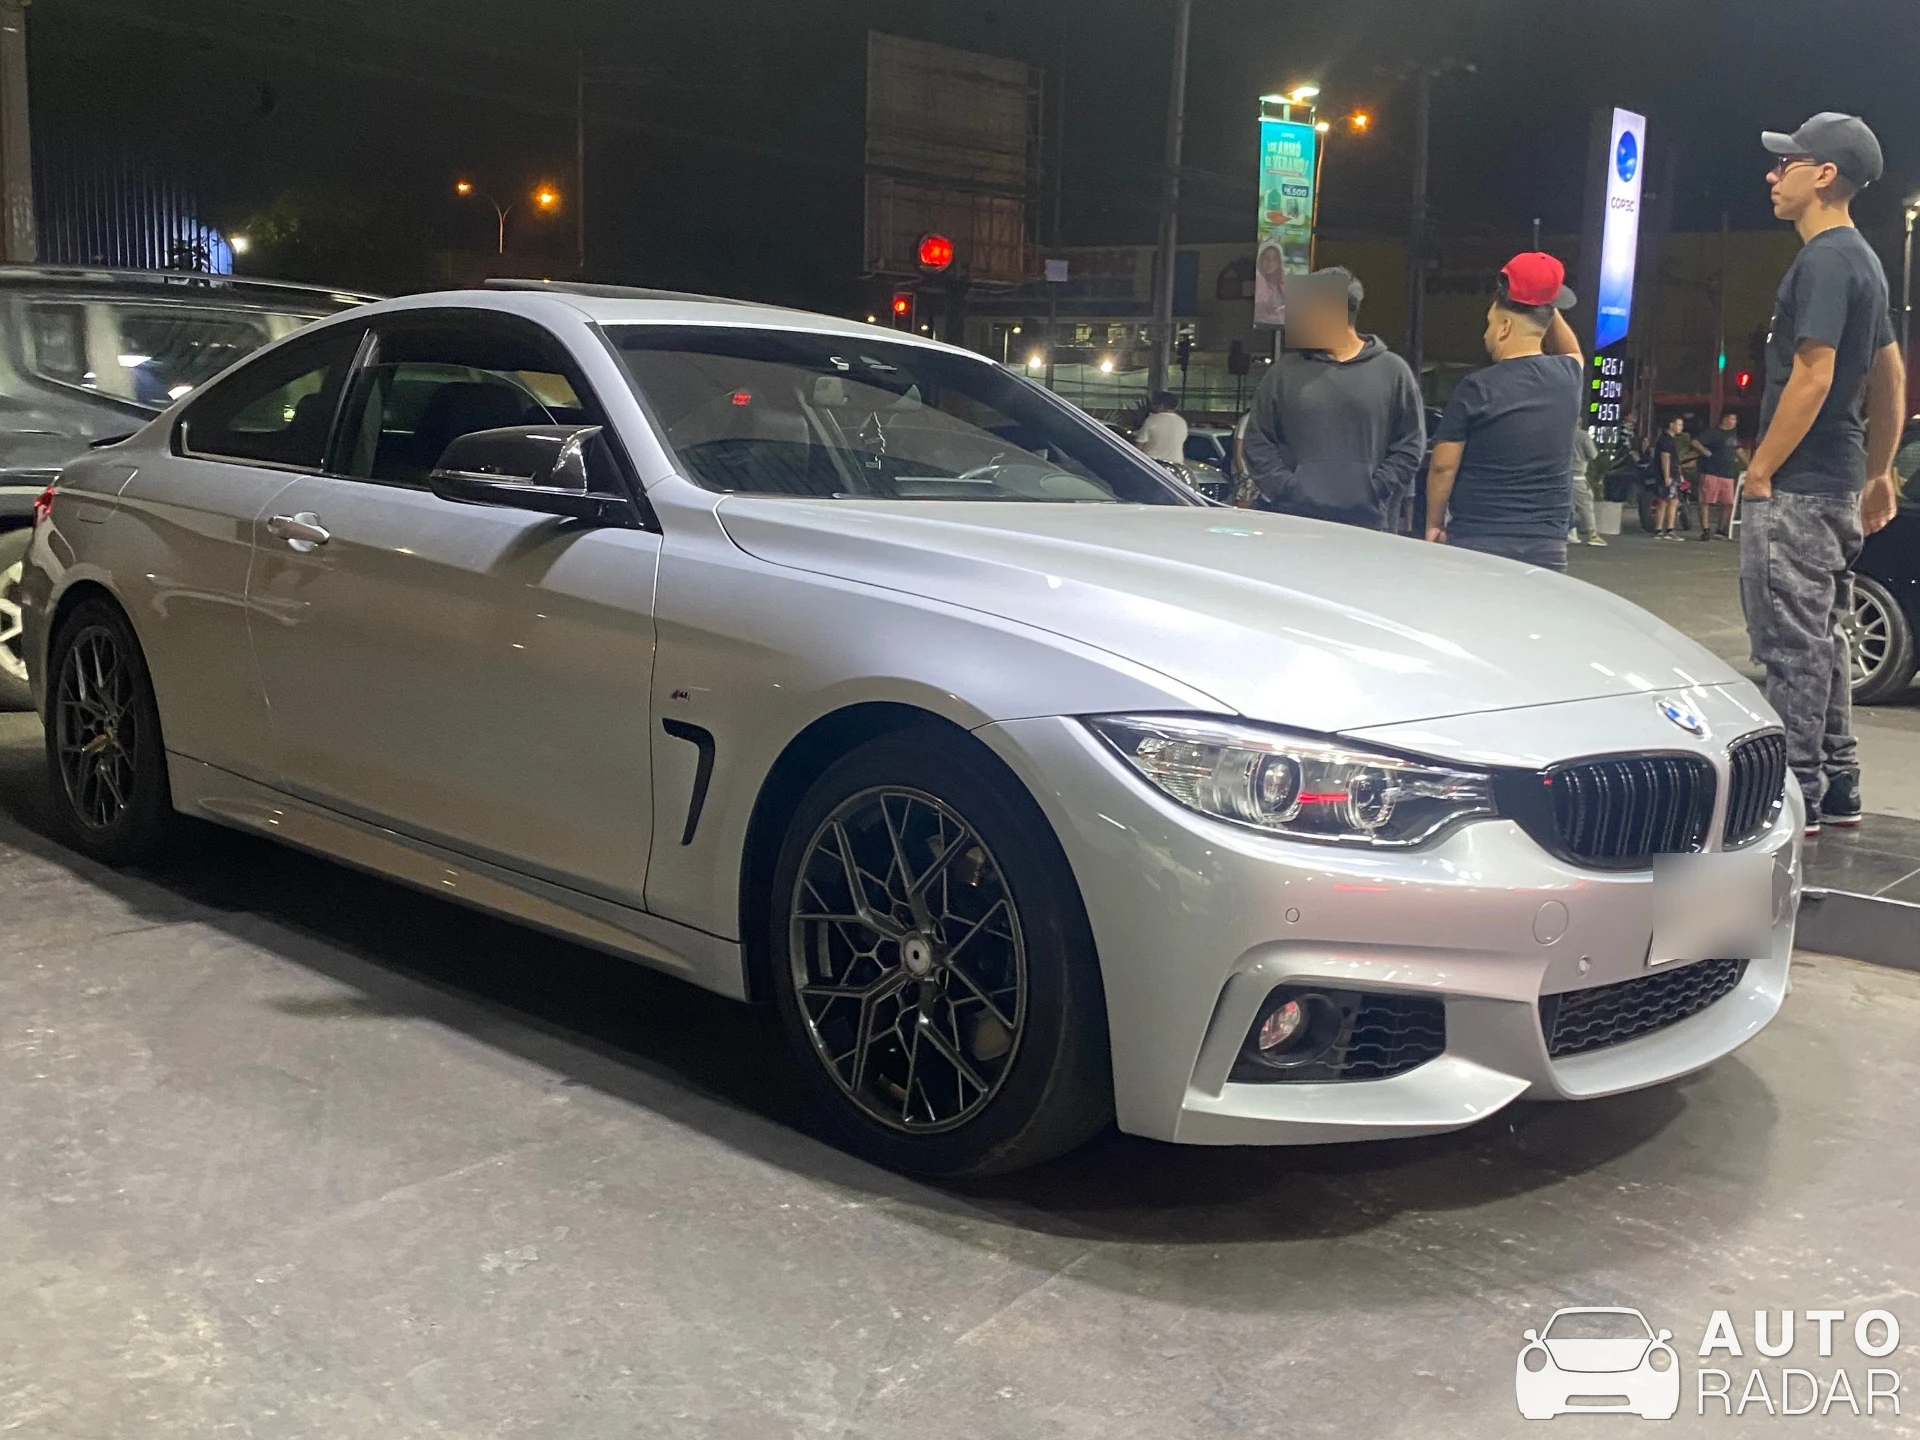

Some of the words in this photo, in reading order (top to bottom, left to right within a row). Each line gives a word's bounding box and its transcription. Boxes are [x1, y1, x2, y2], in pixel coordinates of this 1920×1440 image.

[1601, 357, 1624, 375] 1261
[1600, 380, 1622, 398] 1304
[1598, 403, 1620, 421] 1357
